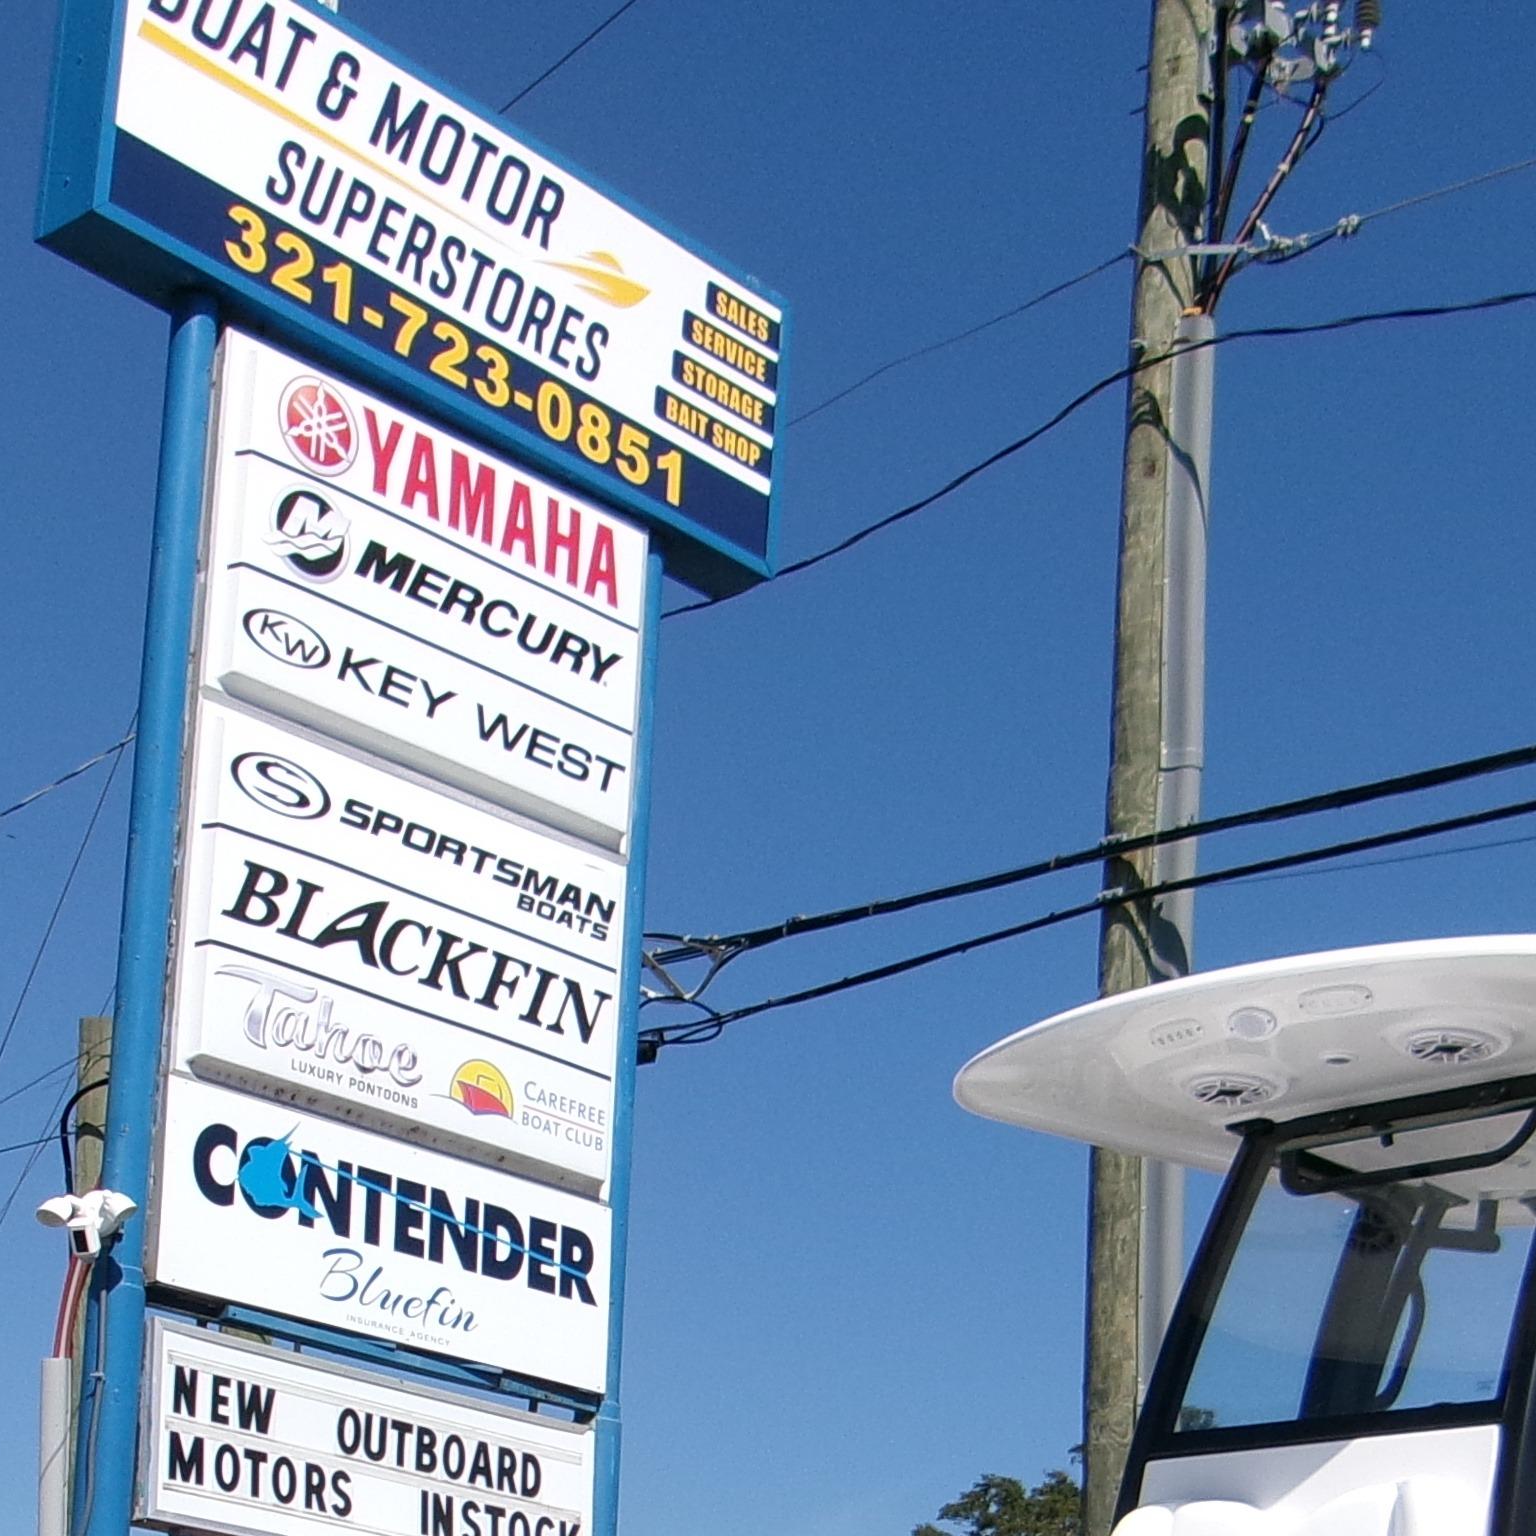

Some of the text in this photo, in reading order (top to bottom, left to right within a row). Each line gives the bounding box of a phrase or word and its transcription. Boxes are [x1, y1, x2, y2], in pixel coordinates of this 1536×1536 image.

[317, 50, 362, 123] &
[369, 81, 566, 250] MOTOR
[266, 139, 609, 382] SUPERSTORES
[224, 204, 684, 507] 321-723-0851
[691, 318, 767, 383] SERVICE
[715, 290, 769, 342] SALES
[666, 395, 761, 467] BAIT SHOP
[682, 358, 763, 426] STORAGE
[363, 406, 618, 609] YAMAHA
[354, 540, 624, 684] MERCURY
[337, 646, 626, 794] KEY WEST
[339, 798, 616, 924] SPORTSMAN
[220, 859, 613, 1045] BLACKFIN
[516, 892, 609, 942] BOATS
[214, 963, 423, 1088] Tahoe
[290, 1057, 418, 1109] LUXURY PONTOONS
[521, 1111, 603, 1151] BOAT CLUB
[524, 1080, 606, 1127] CAREFREE
[192, 1122, 599, 1307] CONTENDER
[320, 1247, 479, 1332] Bluefin
[346, 1313, 451, 1346] INSURANCE AGENCY
[168, 1431, 353, 1518] MOTORS
[172, 1365, 543, 1499] NEW OUTBOARD
